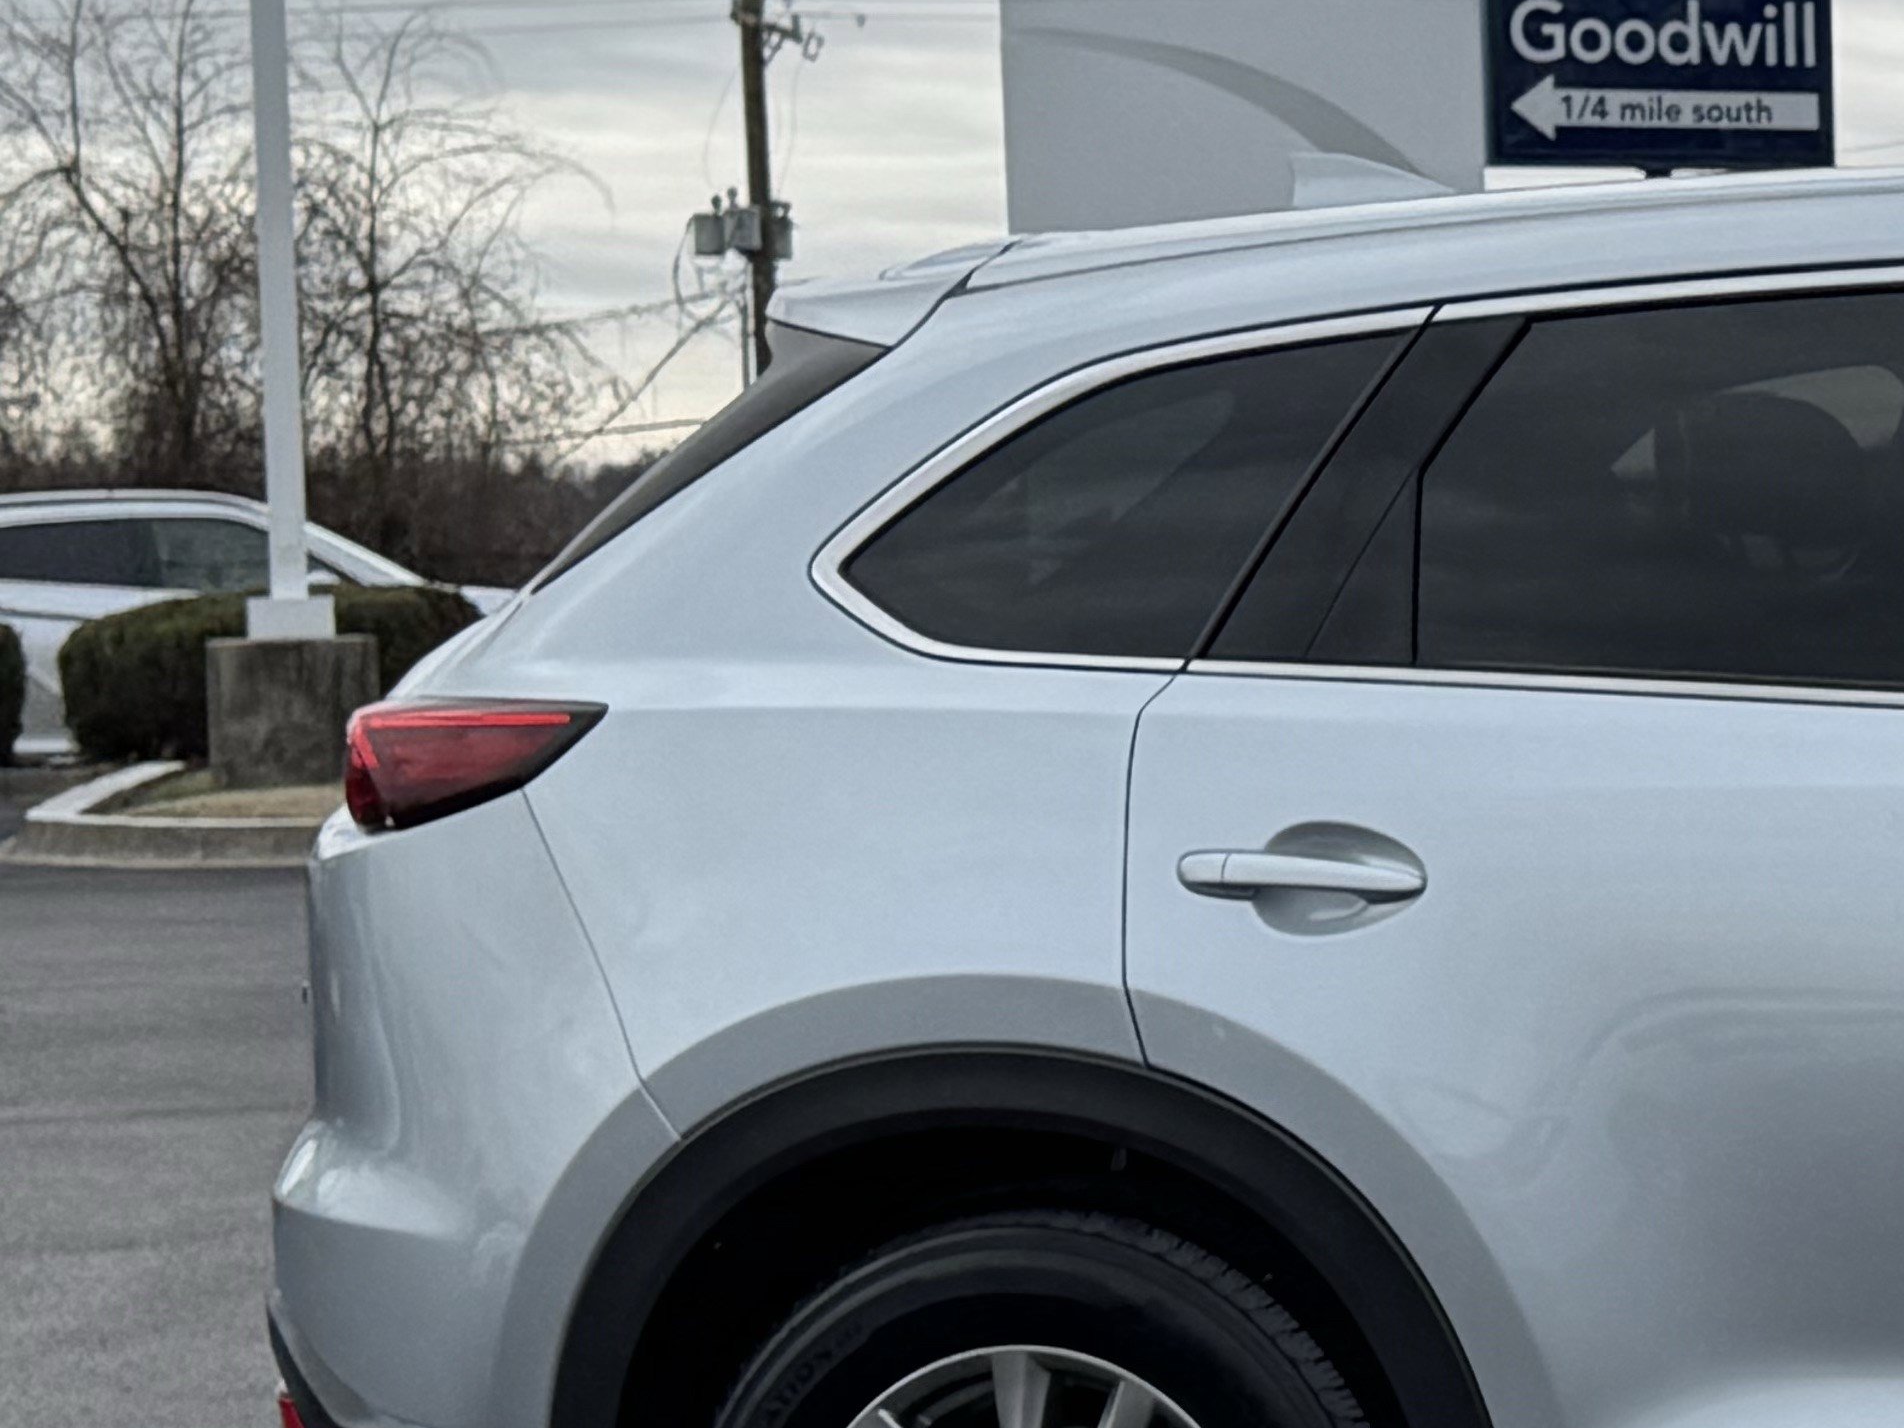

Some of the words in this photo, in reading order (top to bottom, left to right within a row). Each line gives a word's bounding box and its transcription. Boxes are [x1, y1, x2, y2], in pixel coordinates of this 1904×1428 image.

[1560, 94, 1610, 121] 1/4
[1619, 95, 1682, 122] mile
[1692, 98, 1773, 124] south
